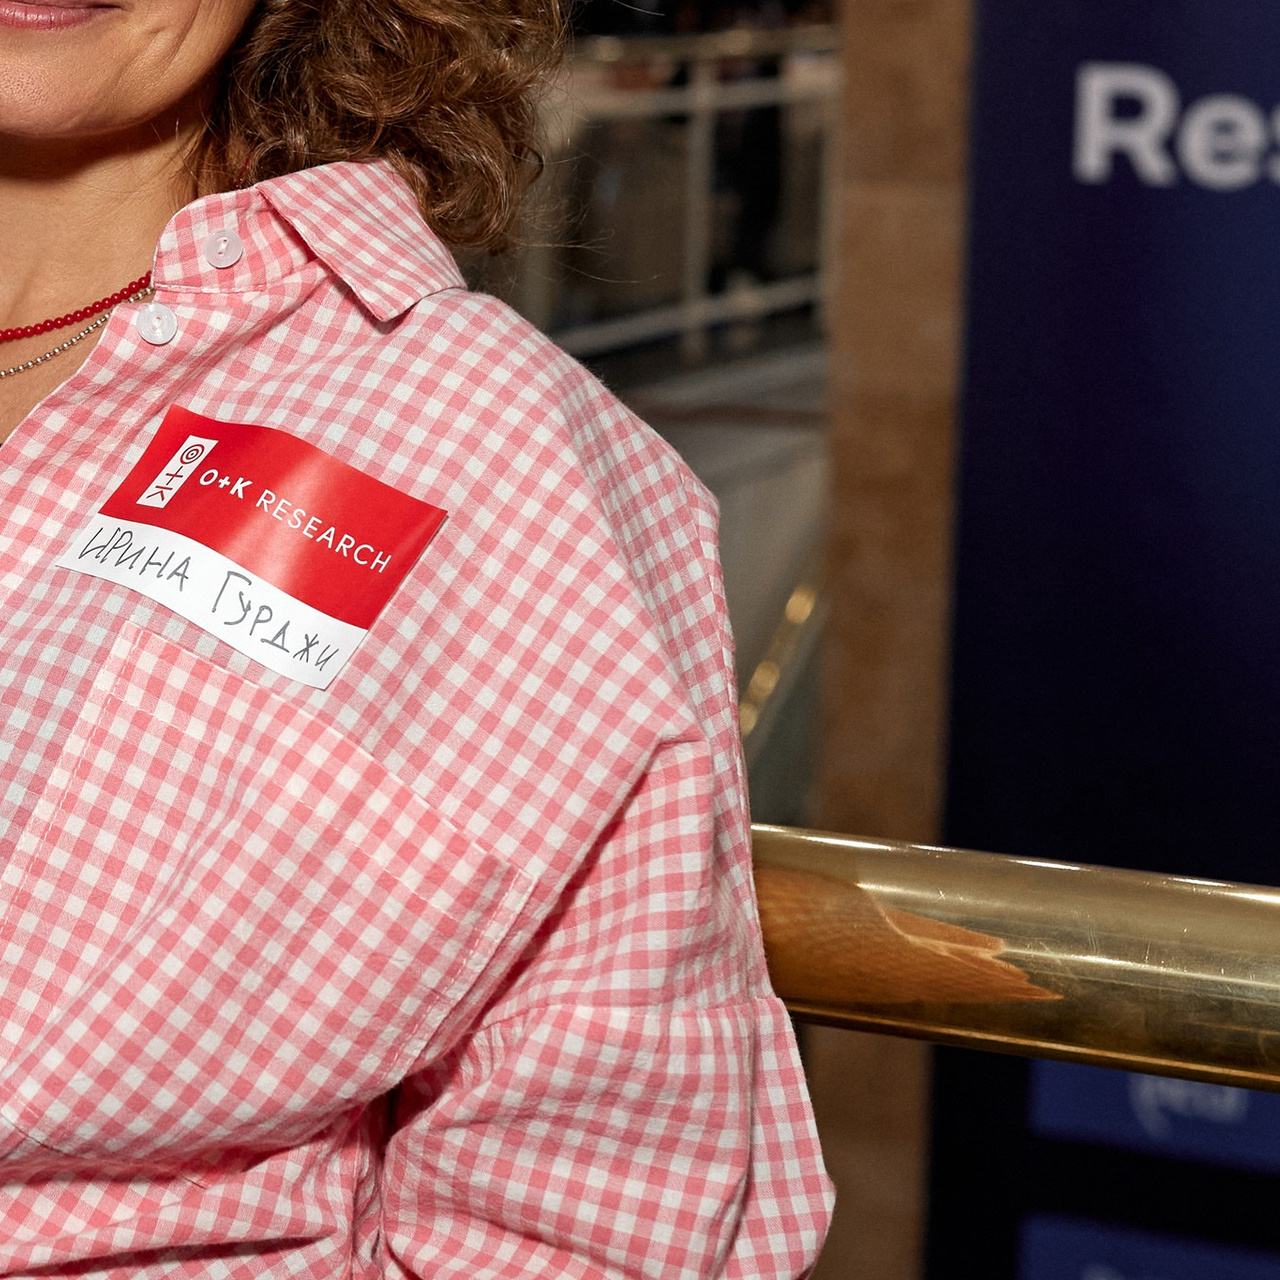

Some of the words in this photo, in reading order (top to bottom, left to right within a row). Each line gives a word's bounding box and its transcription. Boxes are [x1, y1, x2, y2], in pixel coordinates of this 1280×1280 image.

[1073, 58, 1280, 193] Re
[78, 527, 192, 592] ИРИНА
[199, 468, 254, 500] O+K
[255, 488, 393, 573] RESEARCH
